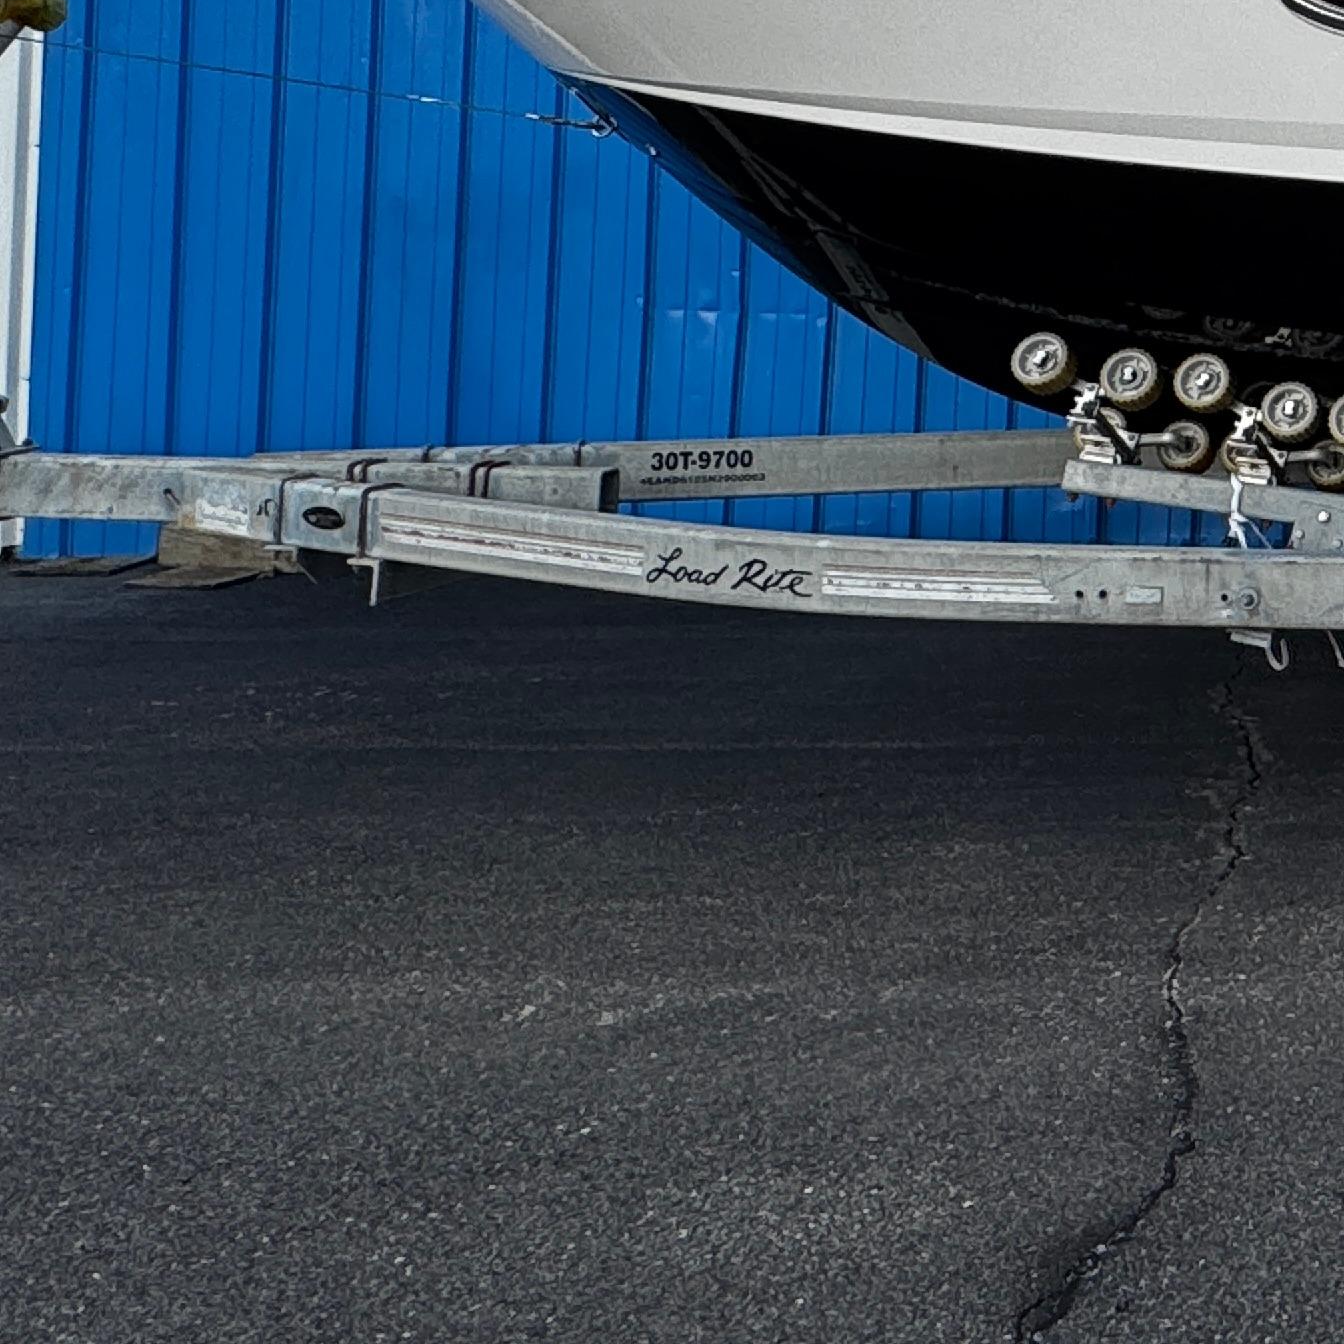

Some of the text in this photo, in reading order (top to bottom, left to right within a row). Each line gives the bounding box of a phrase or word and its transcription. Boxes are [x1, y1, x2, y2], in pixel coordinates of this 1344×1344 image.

[650, 449, 754, 471] 30T-9700
[646, 547, 813, 598] Load Rite
